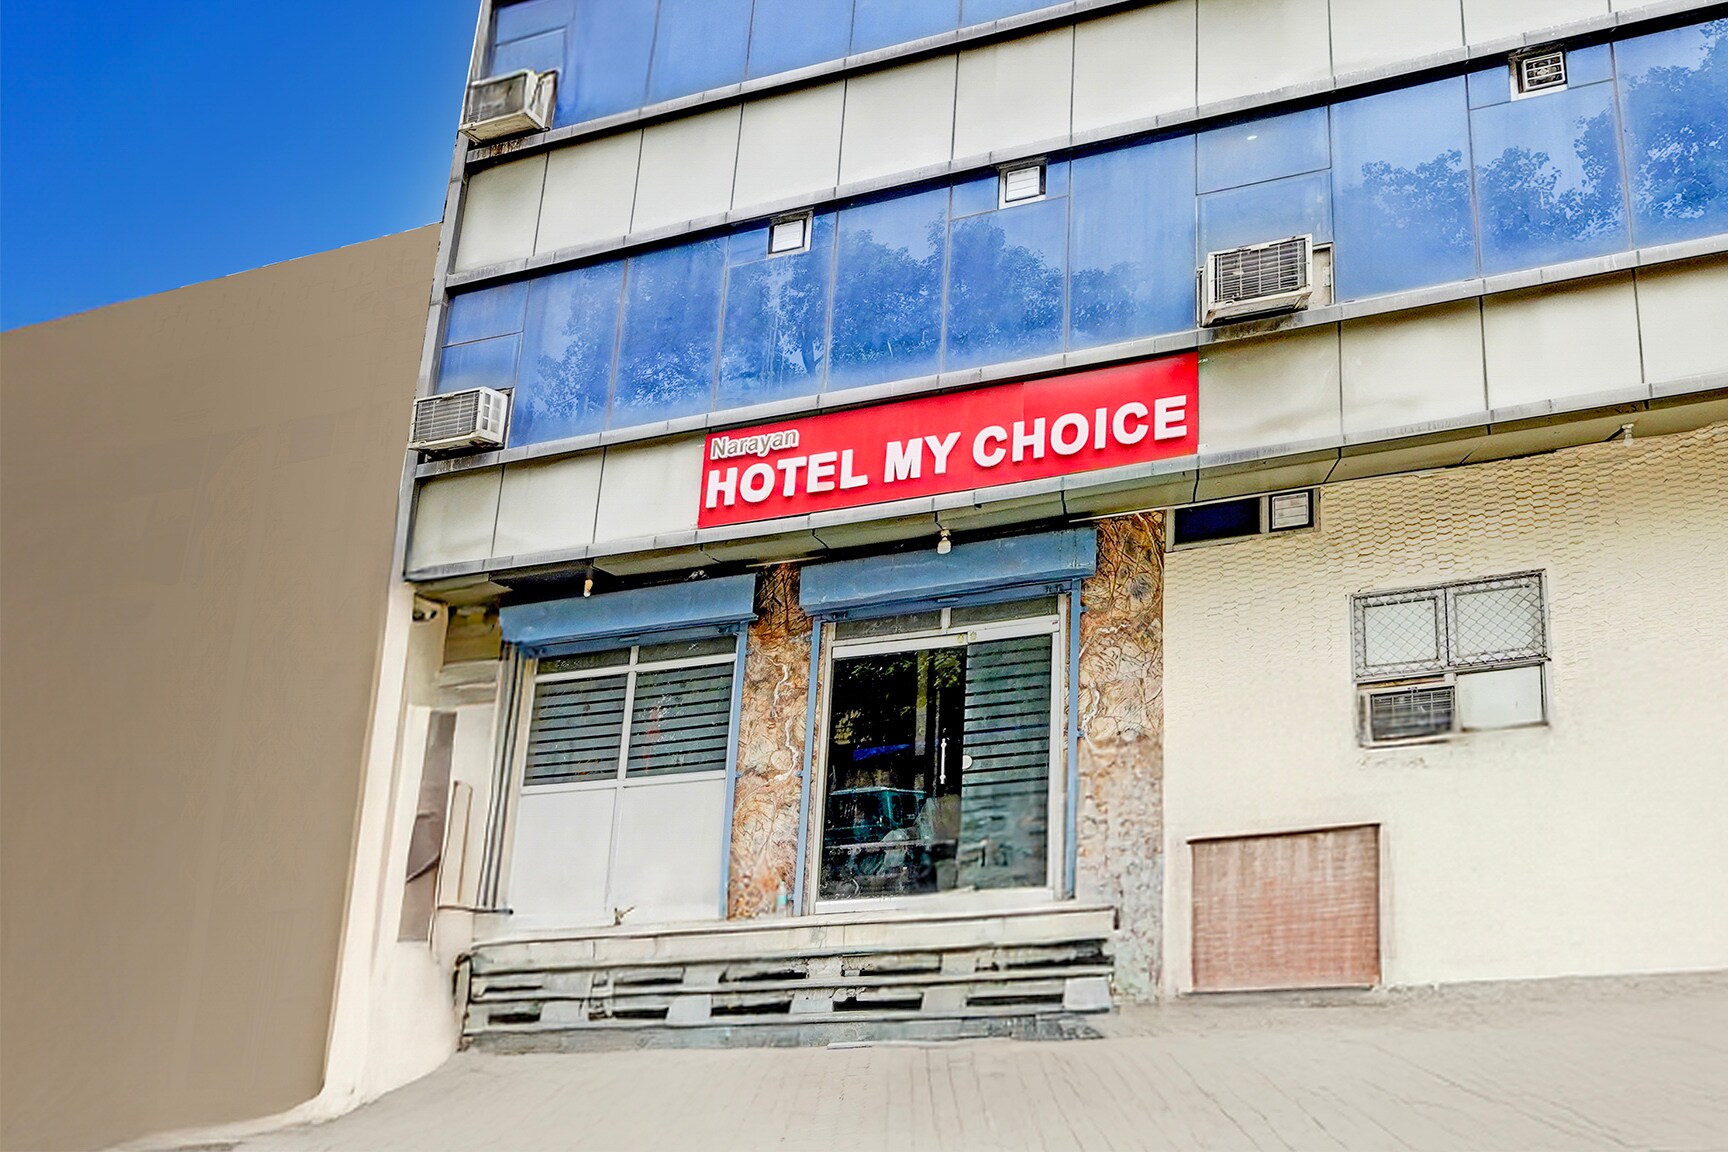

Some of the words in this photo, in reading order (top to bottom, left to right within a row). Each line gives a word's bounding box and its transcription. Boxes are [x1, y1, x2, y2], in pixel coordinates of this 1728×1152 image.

[705, 448, 869, 509] HOTEL
[884, 432, 961, 483] MY
[972, 395, 1187, 468] CHOICE
[710, 429, 800, 460] Narayan
